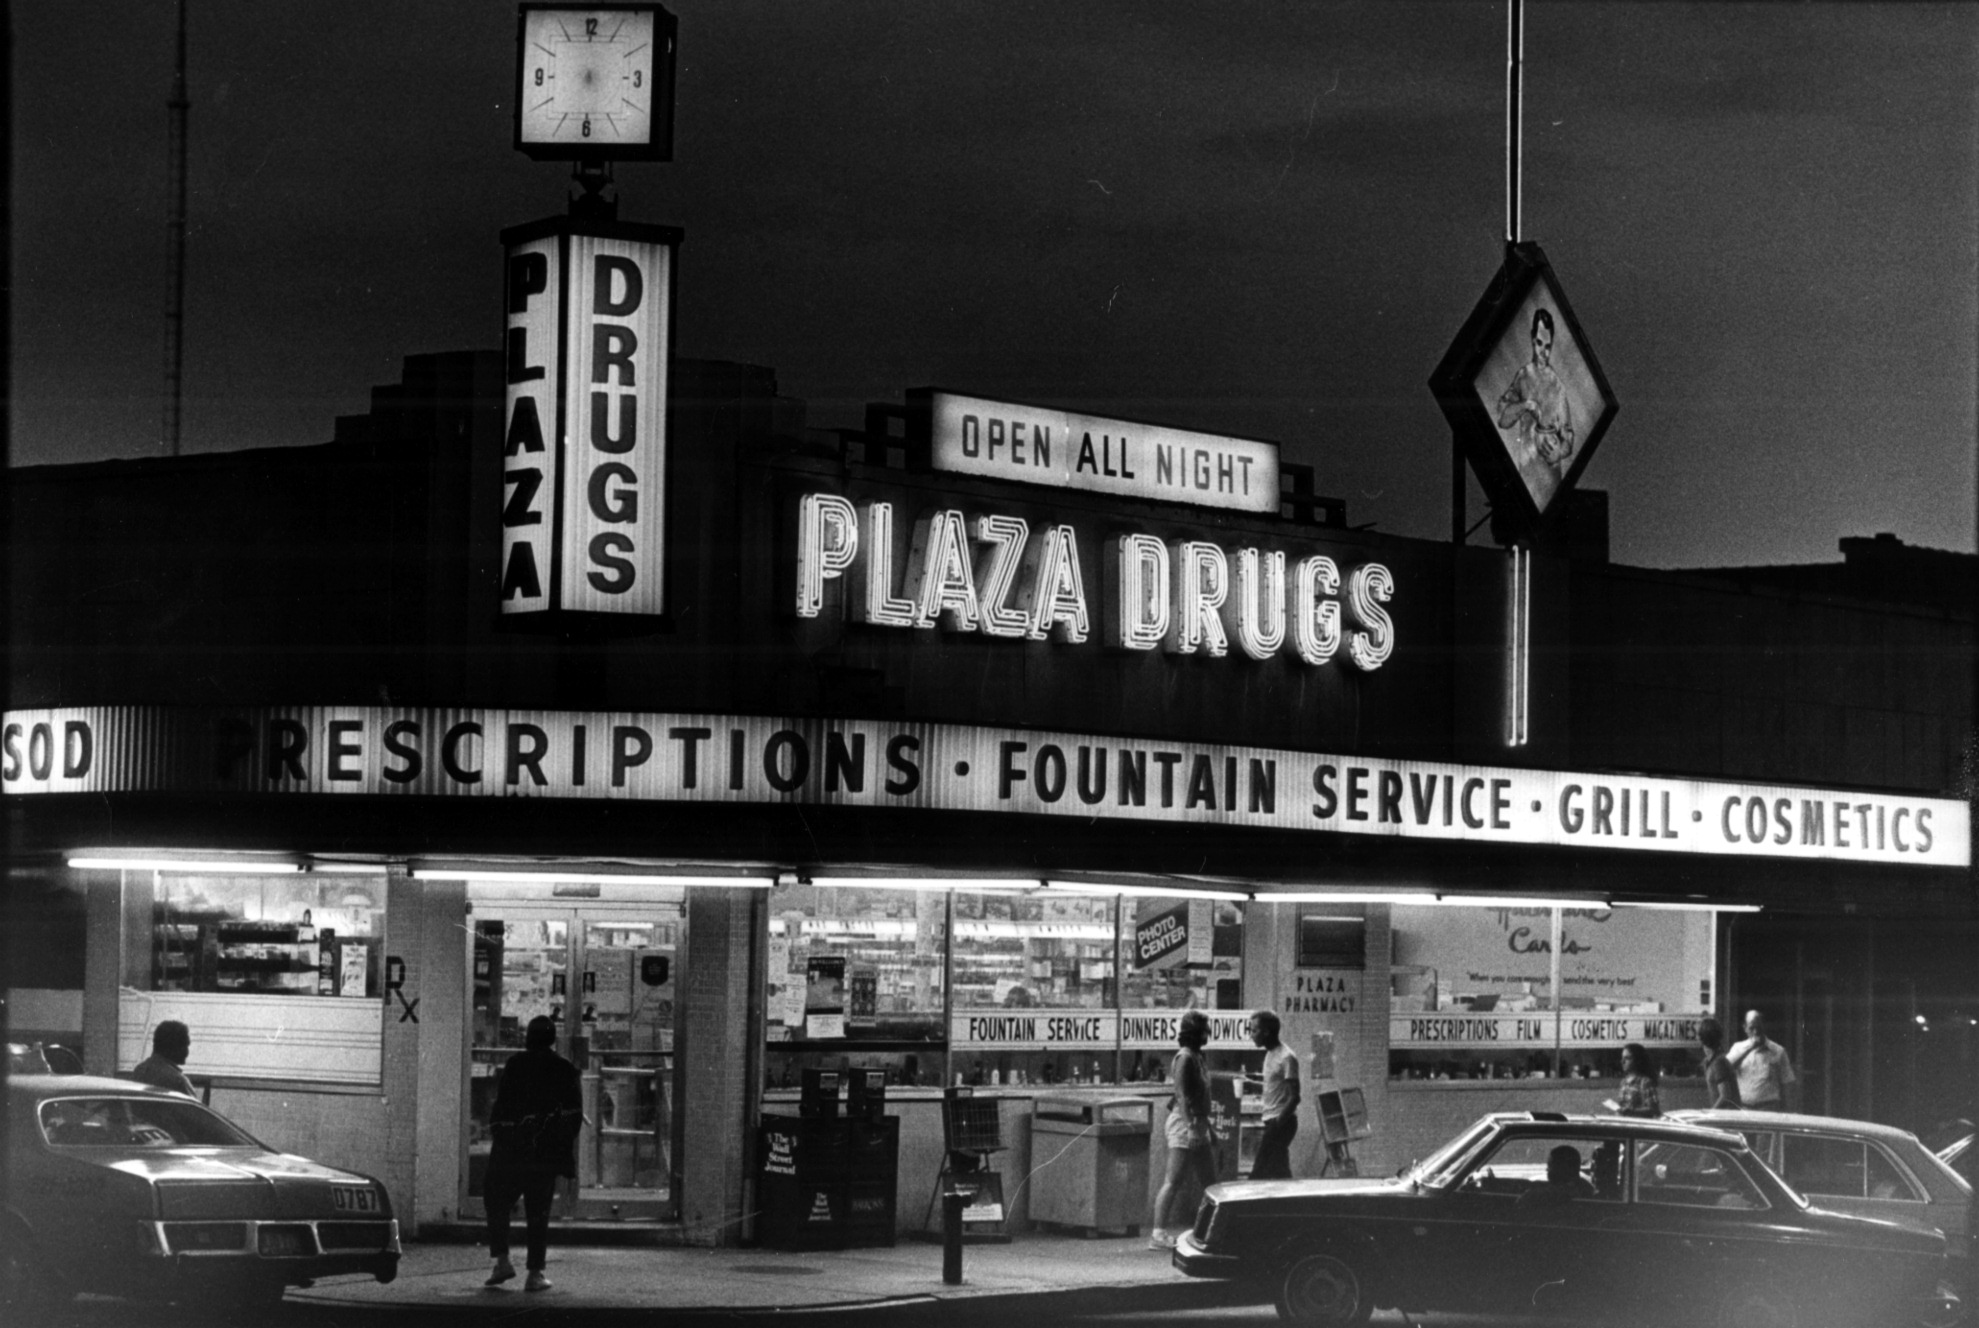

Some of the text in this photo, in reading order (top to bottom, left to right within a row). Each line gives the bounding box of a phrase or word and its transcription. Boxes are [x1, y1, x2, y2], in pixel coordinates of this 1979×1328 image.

[585, 18, 598, 36] 12
[535, 68, 642, 88] 9 3
[582, 120, 591, 137] 6
[501, 252, 547, 601] PLAZA
[587, 254, 643, 595] DRUGS
[962, 414, 1254, 496] OPEN ALL NIGHT
[796, 494, 1394, 671] PLAZA DRUGS
[217, 719, 1933, 853] PRESCRIPTIONS FOUNTAIN SERVICE GRILL COSMETICS
[1138, 915, 1176, 945] PHOTO
[1141, 926, 1186, 960] CENTER
[1297, 977, 1345, 992] PLAZA
[1286, 997, 1355, 1012] PHARMACY
[970, 1018, 1100, 1041] FOUNTAIN SERVICE
[1123, 1017, 1177, 1041] DINNERS
[1411, 1020, 1541, 1041] PRESCRIPTIONS FILM
[1571, 1020, 1697, 1041] COSMETICS MAGAZINES
[774, 1132, 789, 1143] The
[764, 1161, 796, 1175] Journal
[769, 1151, 793, 1164] Street
